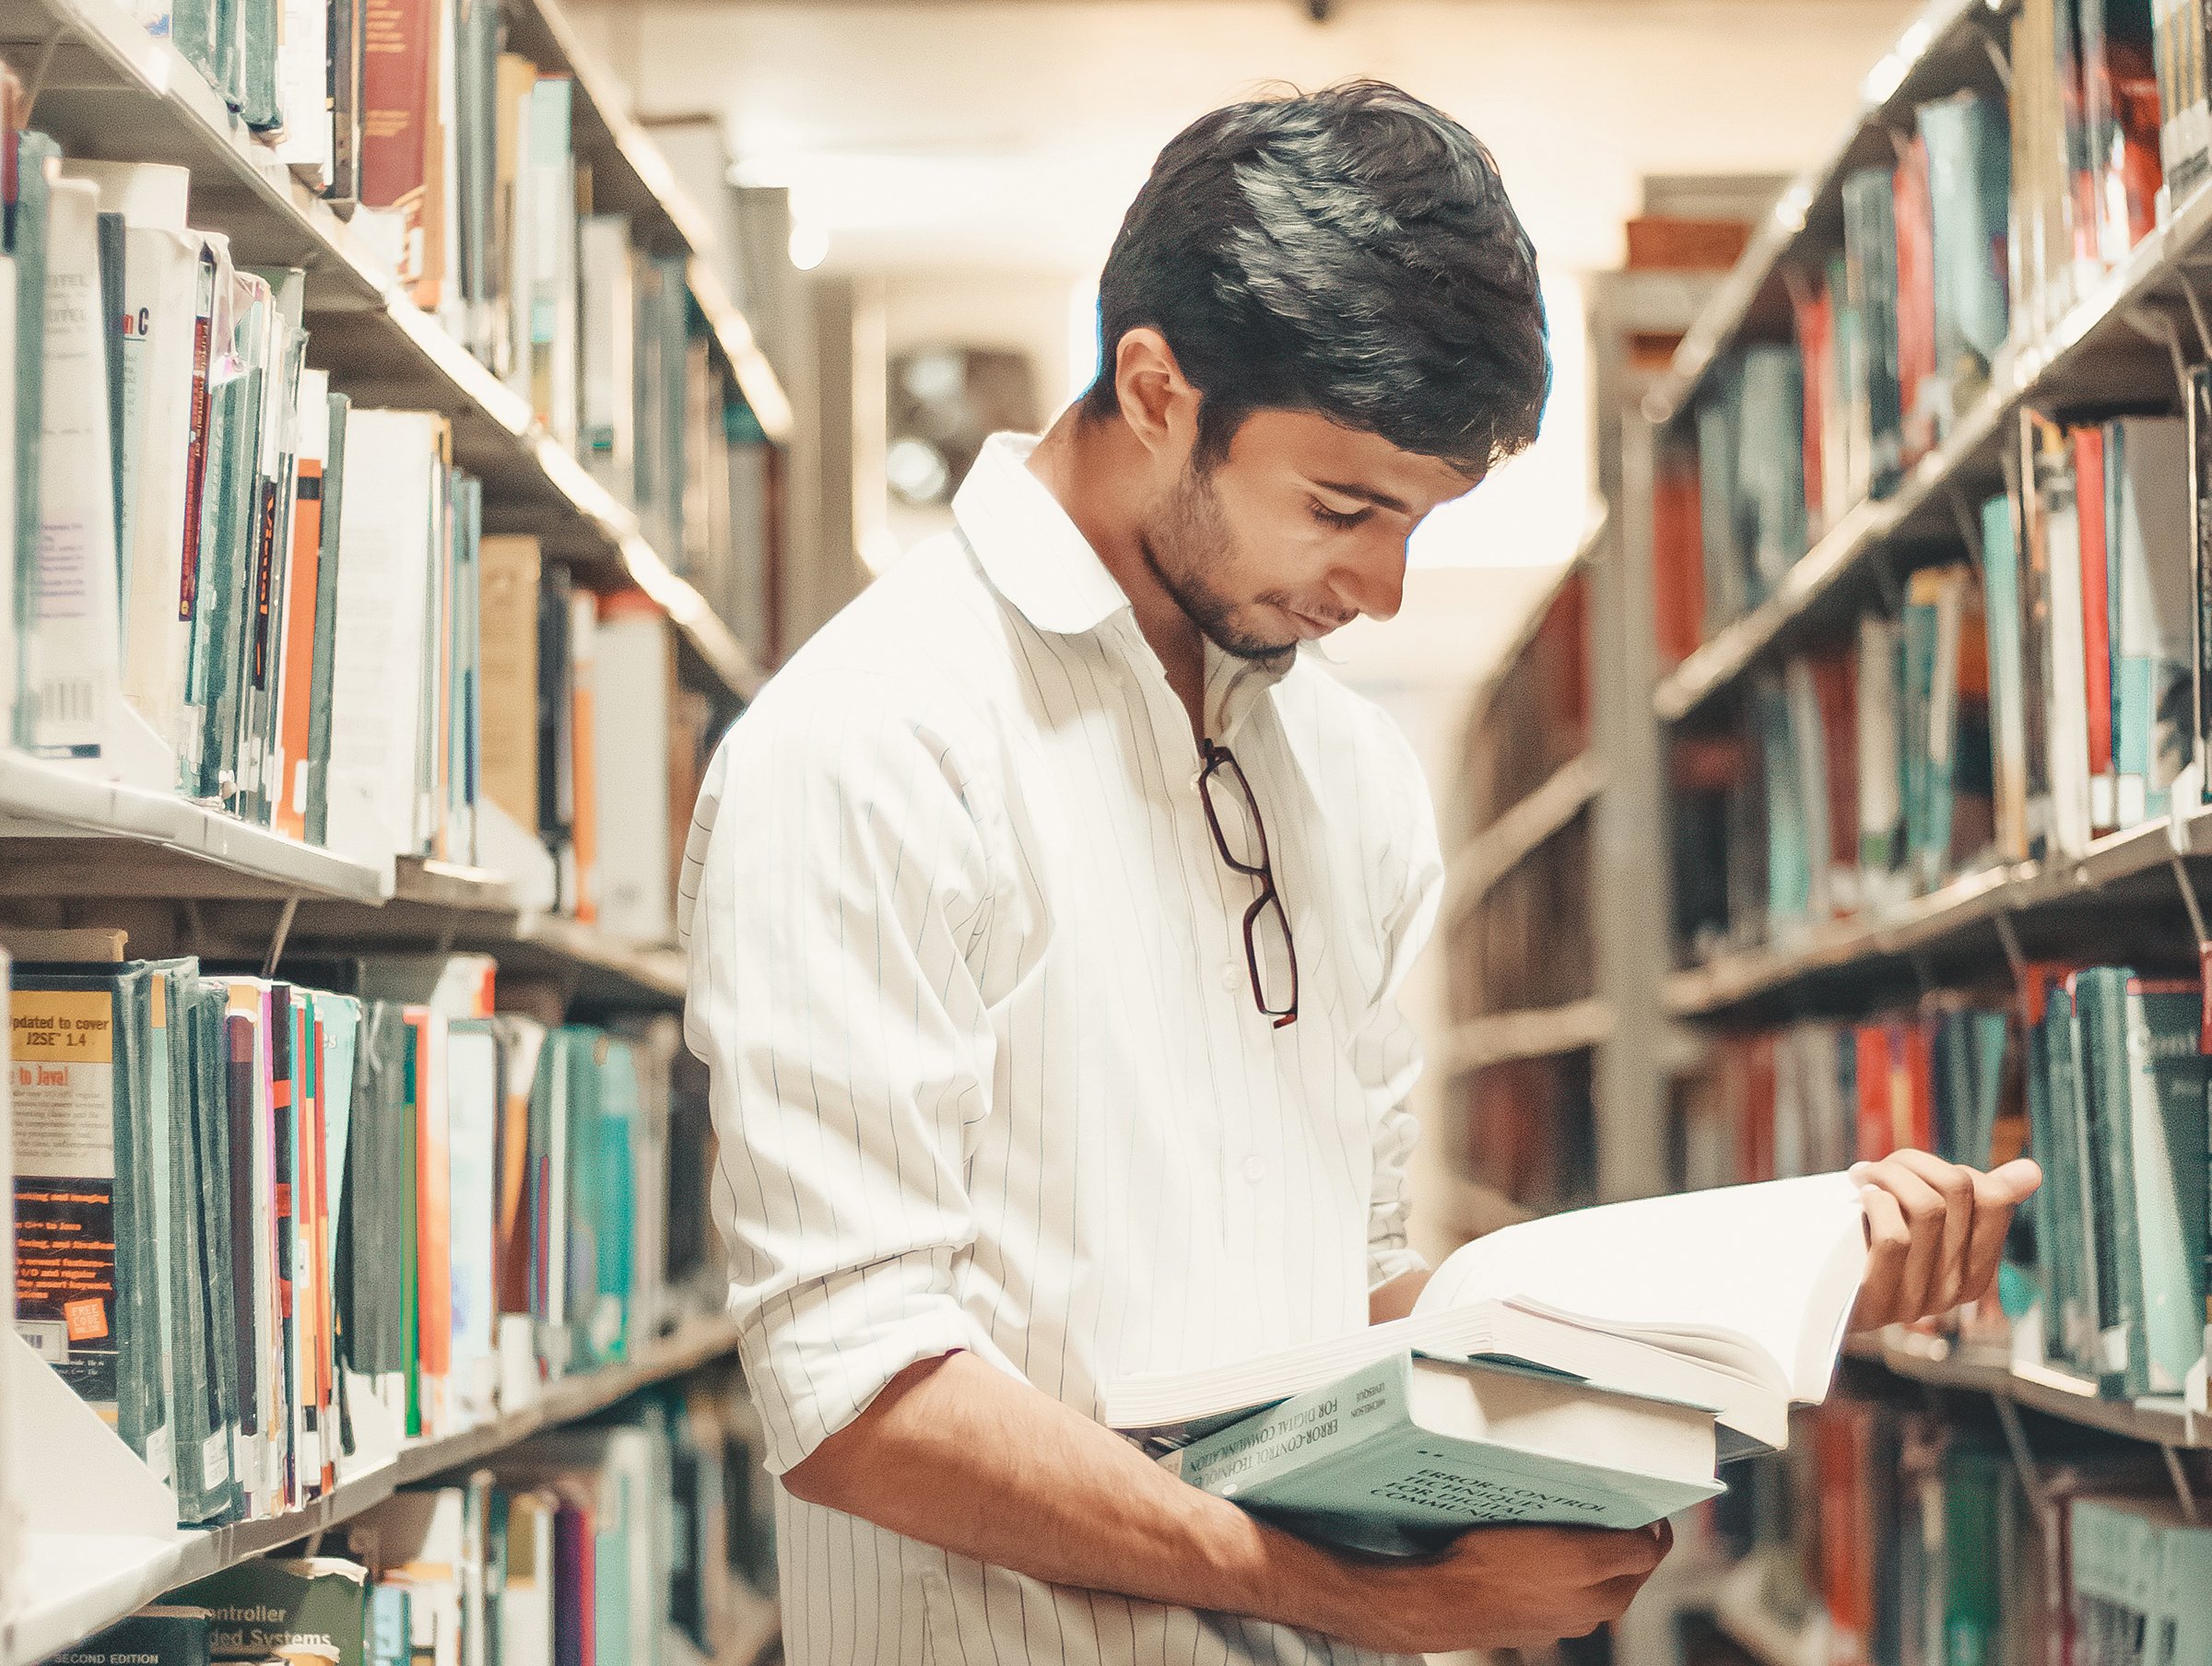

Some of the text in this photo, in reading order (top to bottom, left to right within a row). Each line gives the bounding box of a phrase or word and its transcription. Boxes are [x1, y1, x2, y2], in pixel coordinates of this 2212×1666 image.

[138, 307, 149, 335] C
[12, 1016, 110, 1031] pdated to cover
[66, 1033, 87, 1047] 1.4
[1277, 1407, 1316, 1435] DIGITAL
[1318, 1397, 1337, 1418] FOR
[1255, 1418, 1338, 1467] ERROR-CONTROL
[1385, 1482, 1526, 1516] FOR DIGITAL
[1404, 1475, 1545, 1509] TECHNIQUES
[1417, 1469, 1607, 1512] ERROR-CONTROL
[250, 1628, 332, 1648] Systems
[54, 1653, 159, 1665] SECOND EDITION
